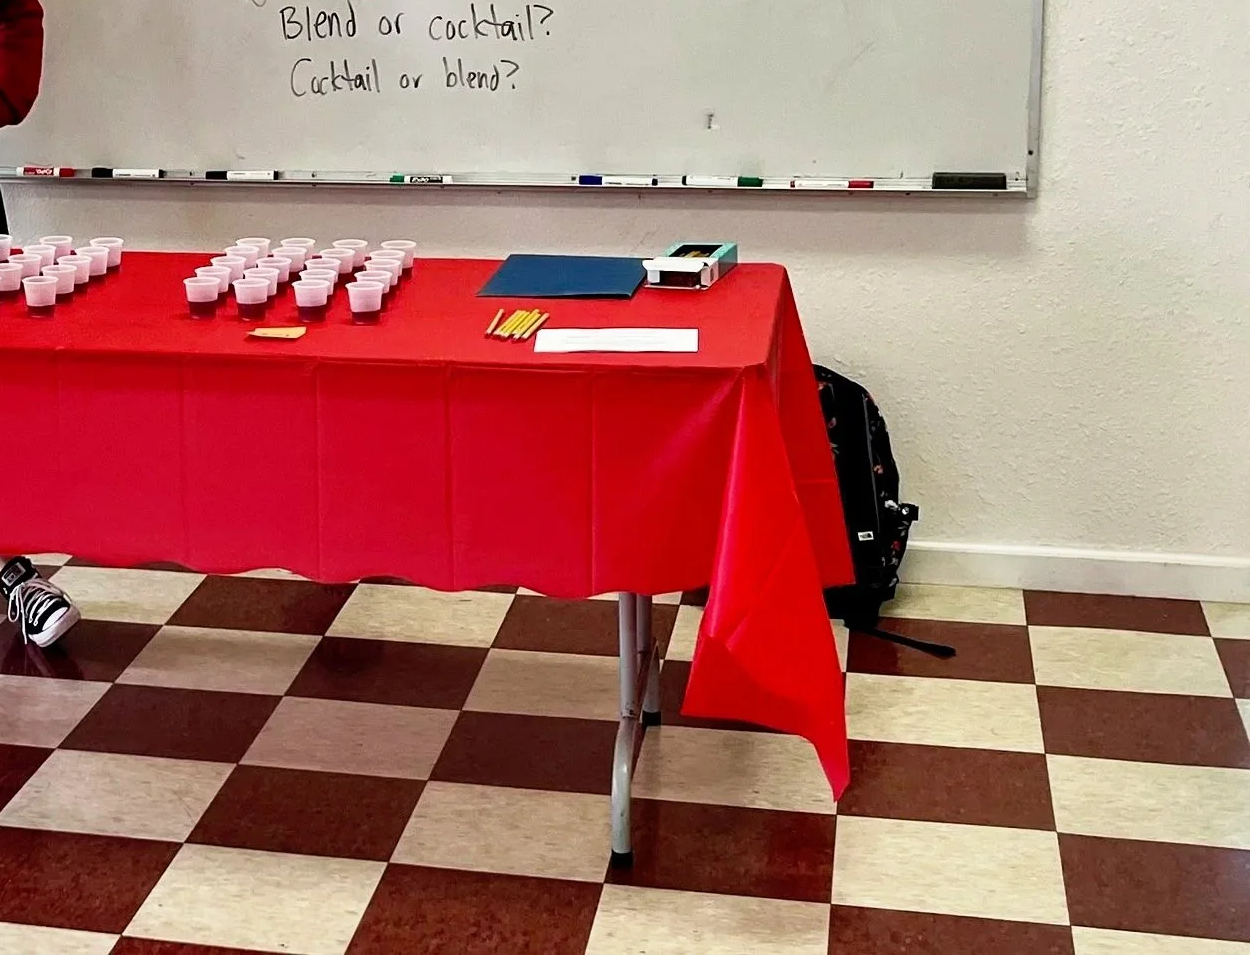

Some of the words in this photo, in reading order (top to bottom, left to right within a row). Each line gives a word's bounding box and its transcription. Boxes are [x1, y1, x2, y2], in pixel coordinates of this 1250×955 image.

[279, 1, 358, 42] Blend
[378, 12, 405, 36] or
[428, 2, 555, 42] cocktail?
[399, 72, 424, 89] or
[442, 56, 520, 92] blend?
